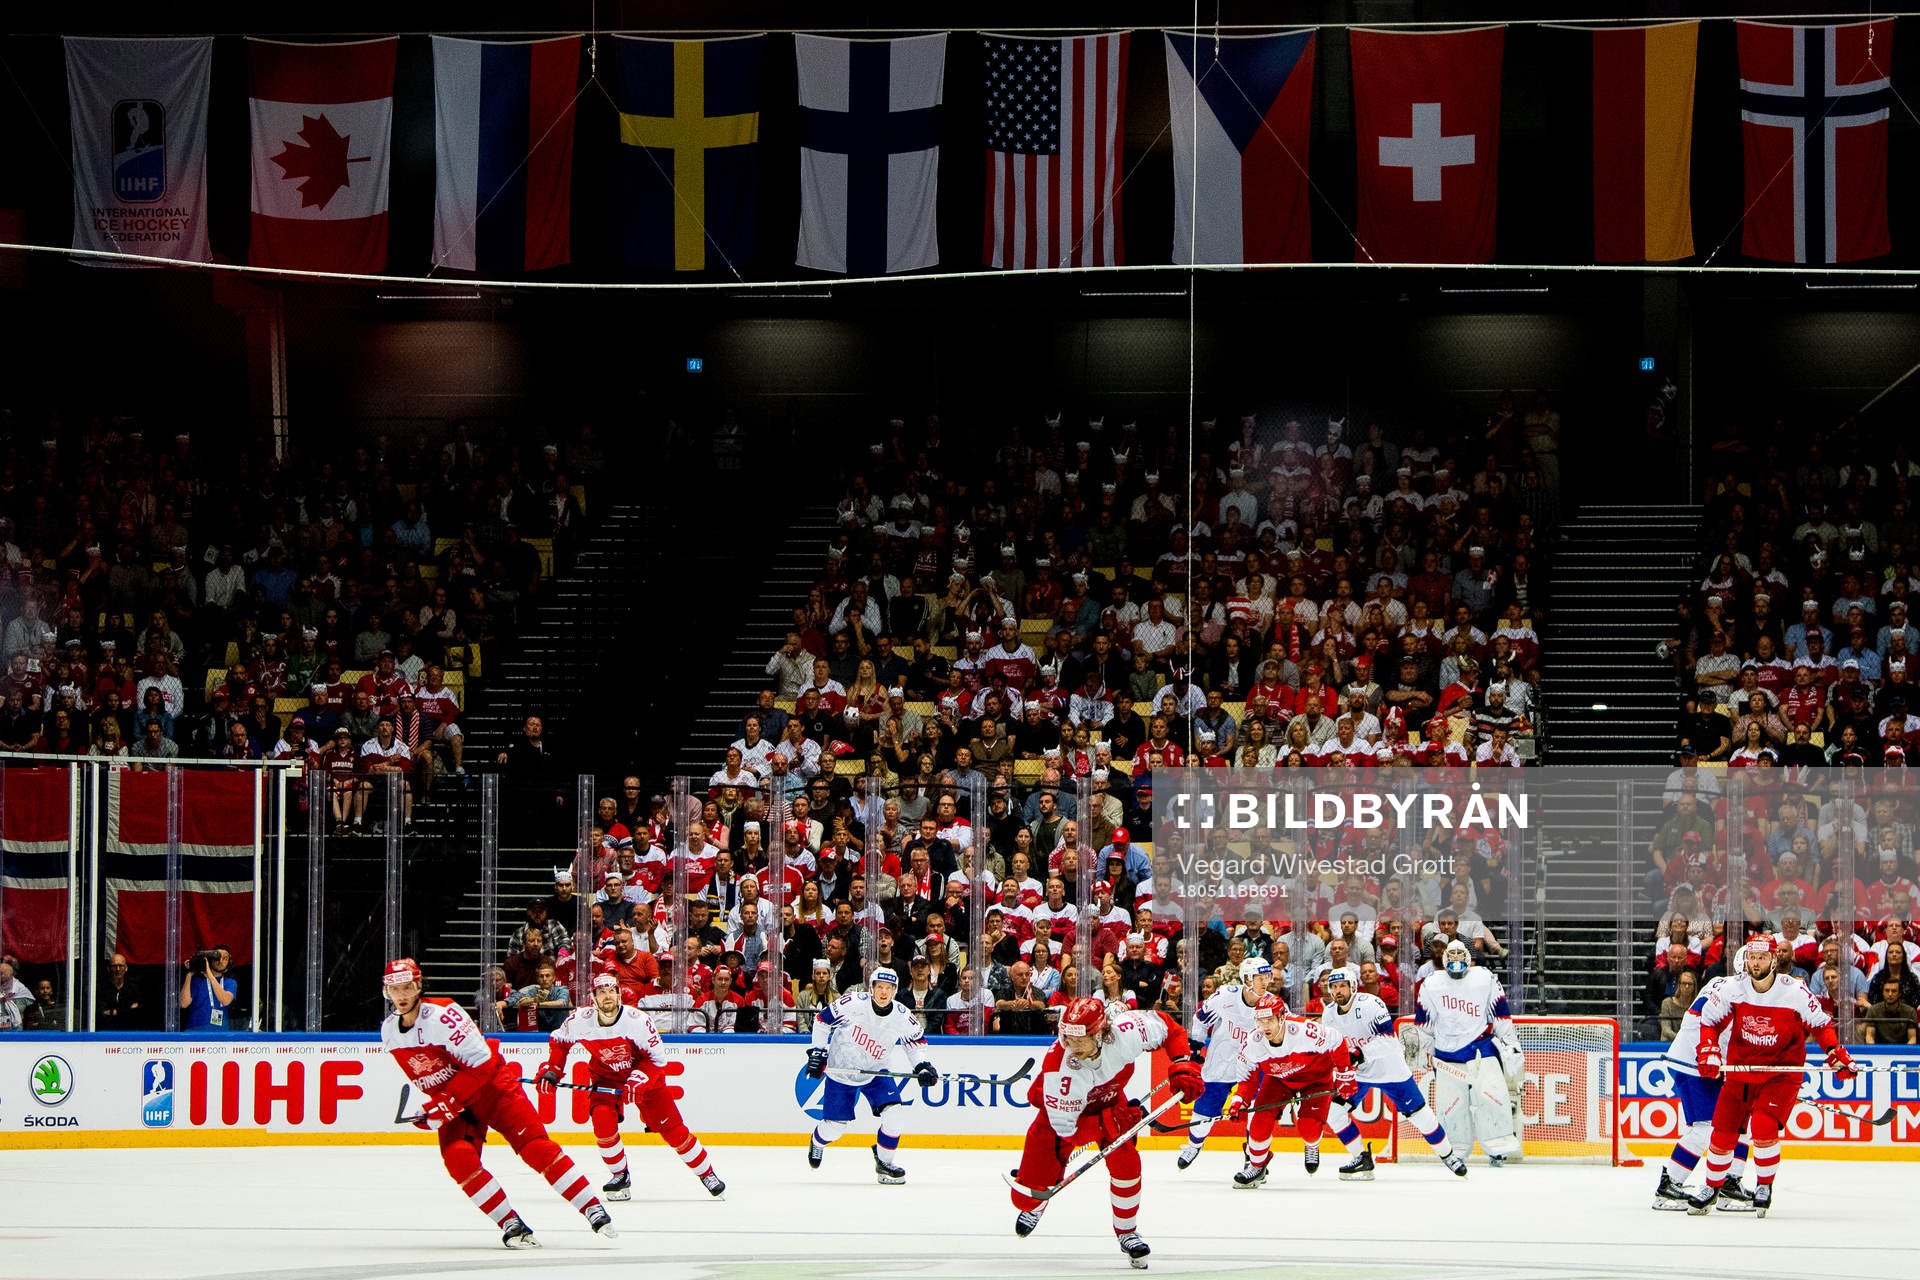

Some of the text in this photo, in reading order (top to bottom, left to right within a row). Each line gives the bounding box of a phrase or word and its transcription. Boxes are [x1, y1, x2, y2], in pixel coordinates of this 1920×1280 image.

[120, 177, 159, 192] IIHF
[92, 207, 189, 218] INTERNATIONAL
[94, 218, 190, 231] ICE HOCKEY
[103, 231, 181, 242] FEDERATION
[1441, 994, 1481, 1018] NORGE
[440, 1007, 463, 1029] 93
[1355, 1008, 1362, 1020] C
[1117, 1020, 1135, 1033] 3
[1305, 1022, 1318, 1040] 63
[417, 1028, 424, 1046] C
[851, 1025, 887, 1061] NORGE
[1741, 1029, 1779, 1046] DANMARK
[147, 1047, 184, 1055] IIHF.com
[190, 1047, 227, 1055] IIHF.com
[233, 1047, 271, 1055] IIHF.com
[276, 1047, 315, 1055] IIHF.com
[320, 1047, 360, 1055] IIHF.com
[502, 1047, 542, 1055] IIHF.com
[685, 1047, 725, 1055] IIHF.com
[1060, 1076, 1073, 1096] 3
[189, 1060, 364, 1126] IIHF
[145, 1110, 170, 1121] IIHF
[1059, 1105, 1081, 1113] METAL
[24, 1115, 79, 1127] ŠKODA
